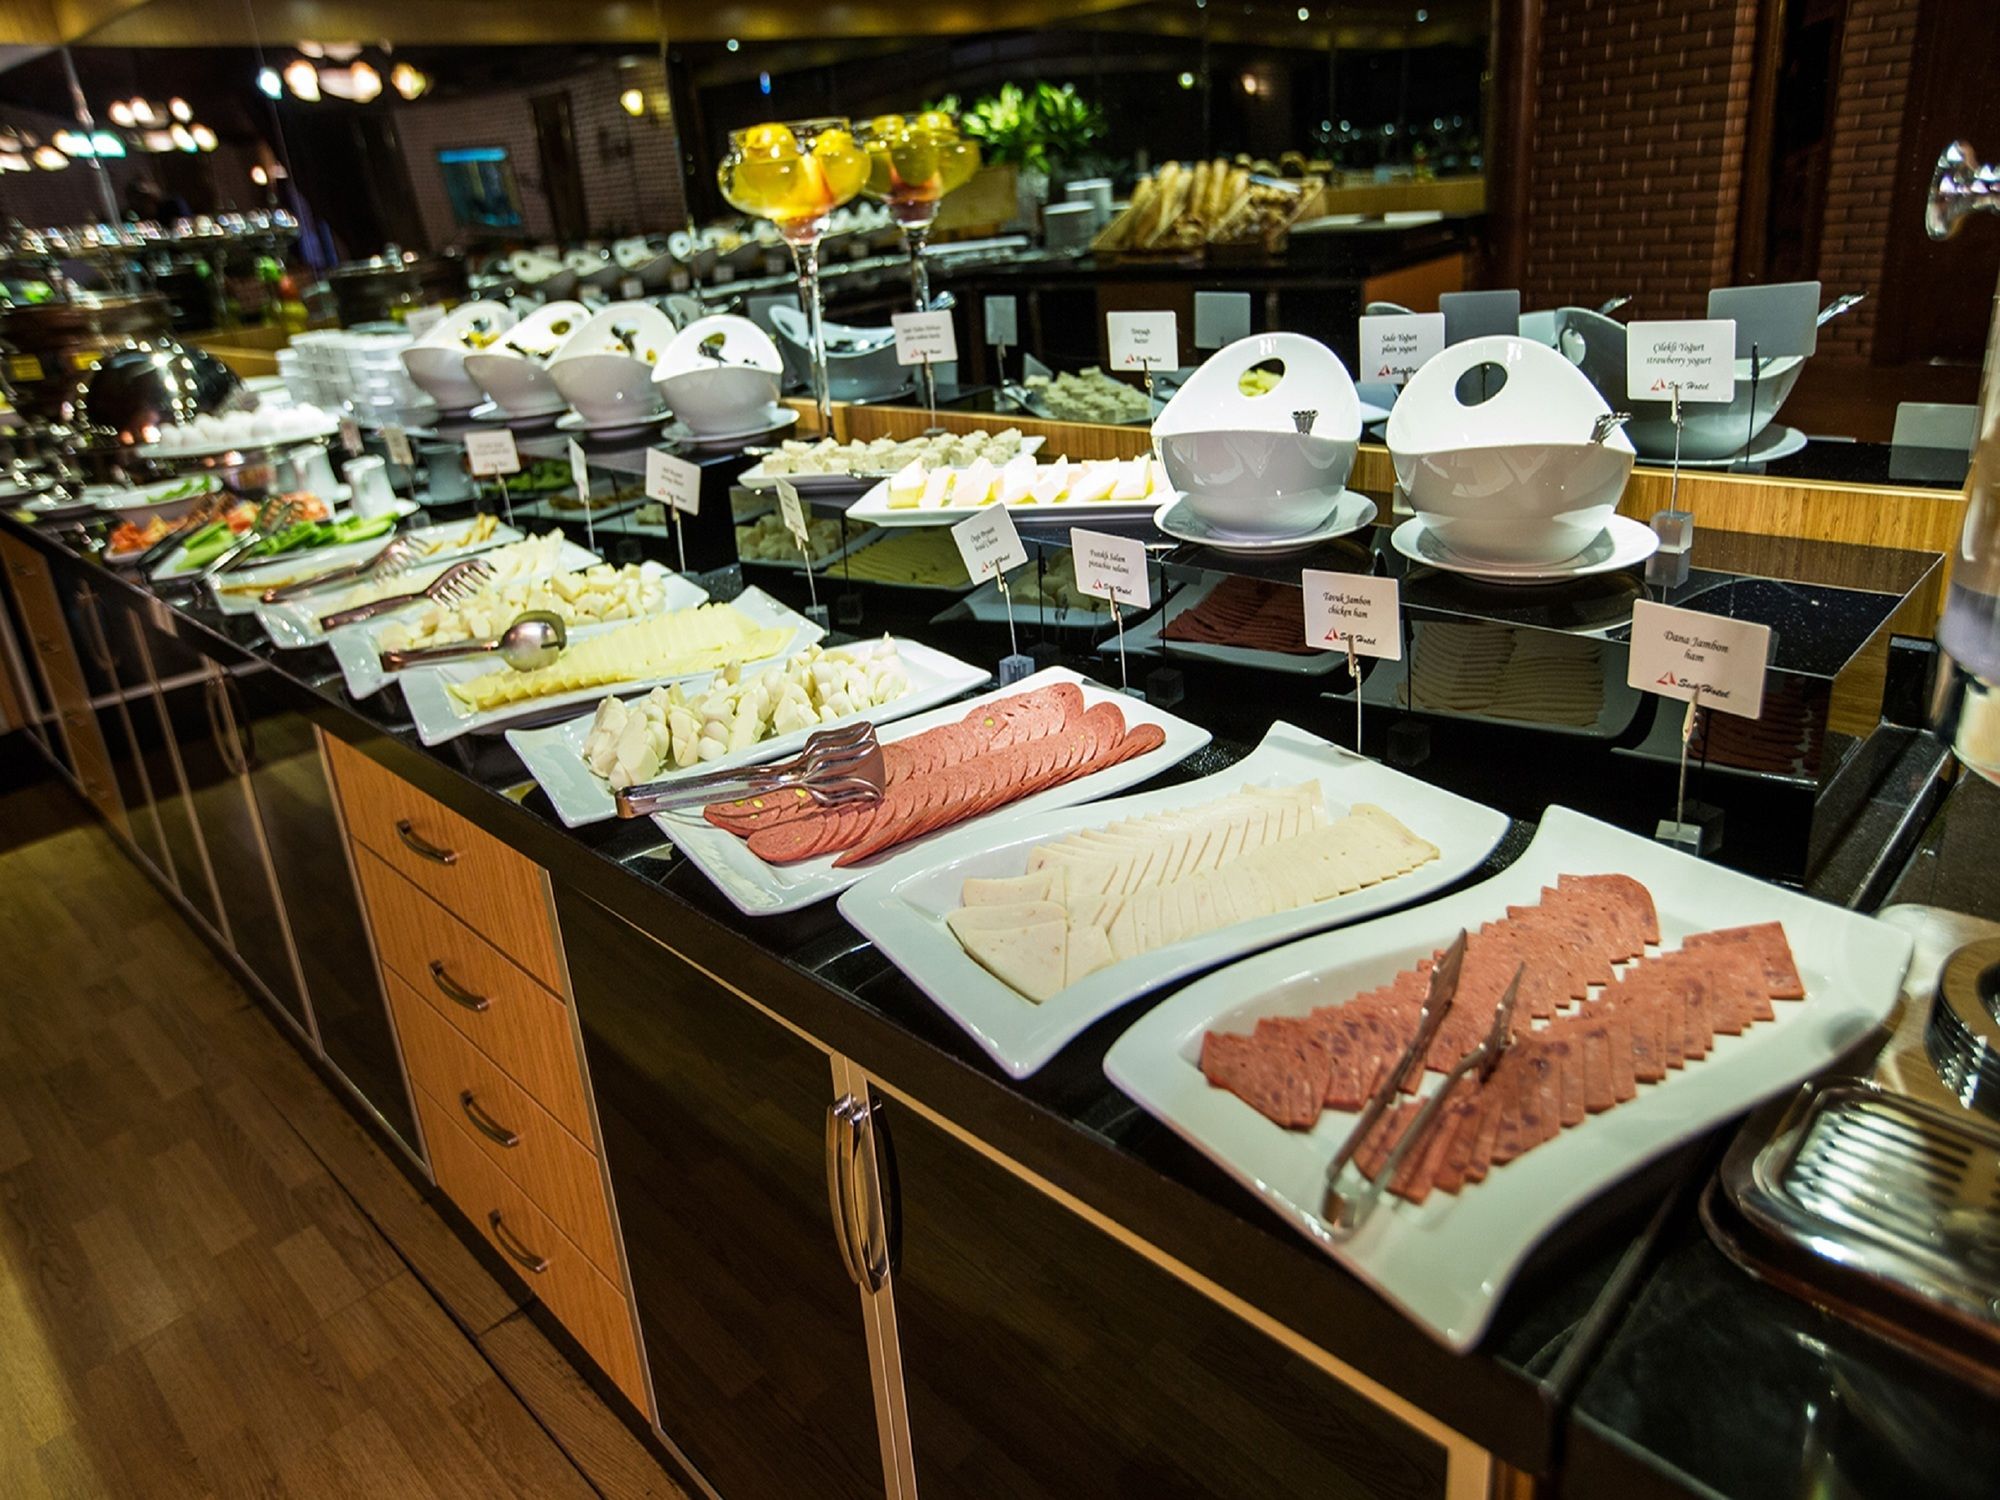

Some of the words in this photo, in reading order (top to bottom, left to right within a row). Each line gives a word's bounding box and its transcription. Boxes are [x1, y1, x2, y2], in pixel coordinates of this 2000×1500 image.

[1646, 355, 1686, 367] strawberry
[1686, 356, 1712, 368] yogurt
[1328, 604, 1352, 618] chicken
[1353, 608, 1368, 619] ham
[1355, 634, 1377, 646] Hotel
[1664, 630, 1690, 645] Dana
[1690, 636, 1729, 653] Jambon
[1683, 649, 1705, 662] ham
[1699, 684, 1731, 699] Hotel
